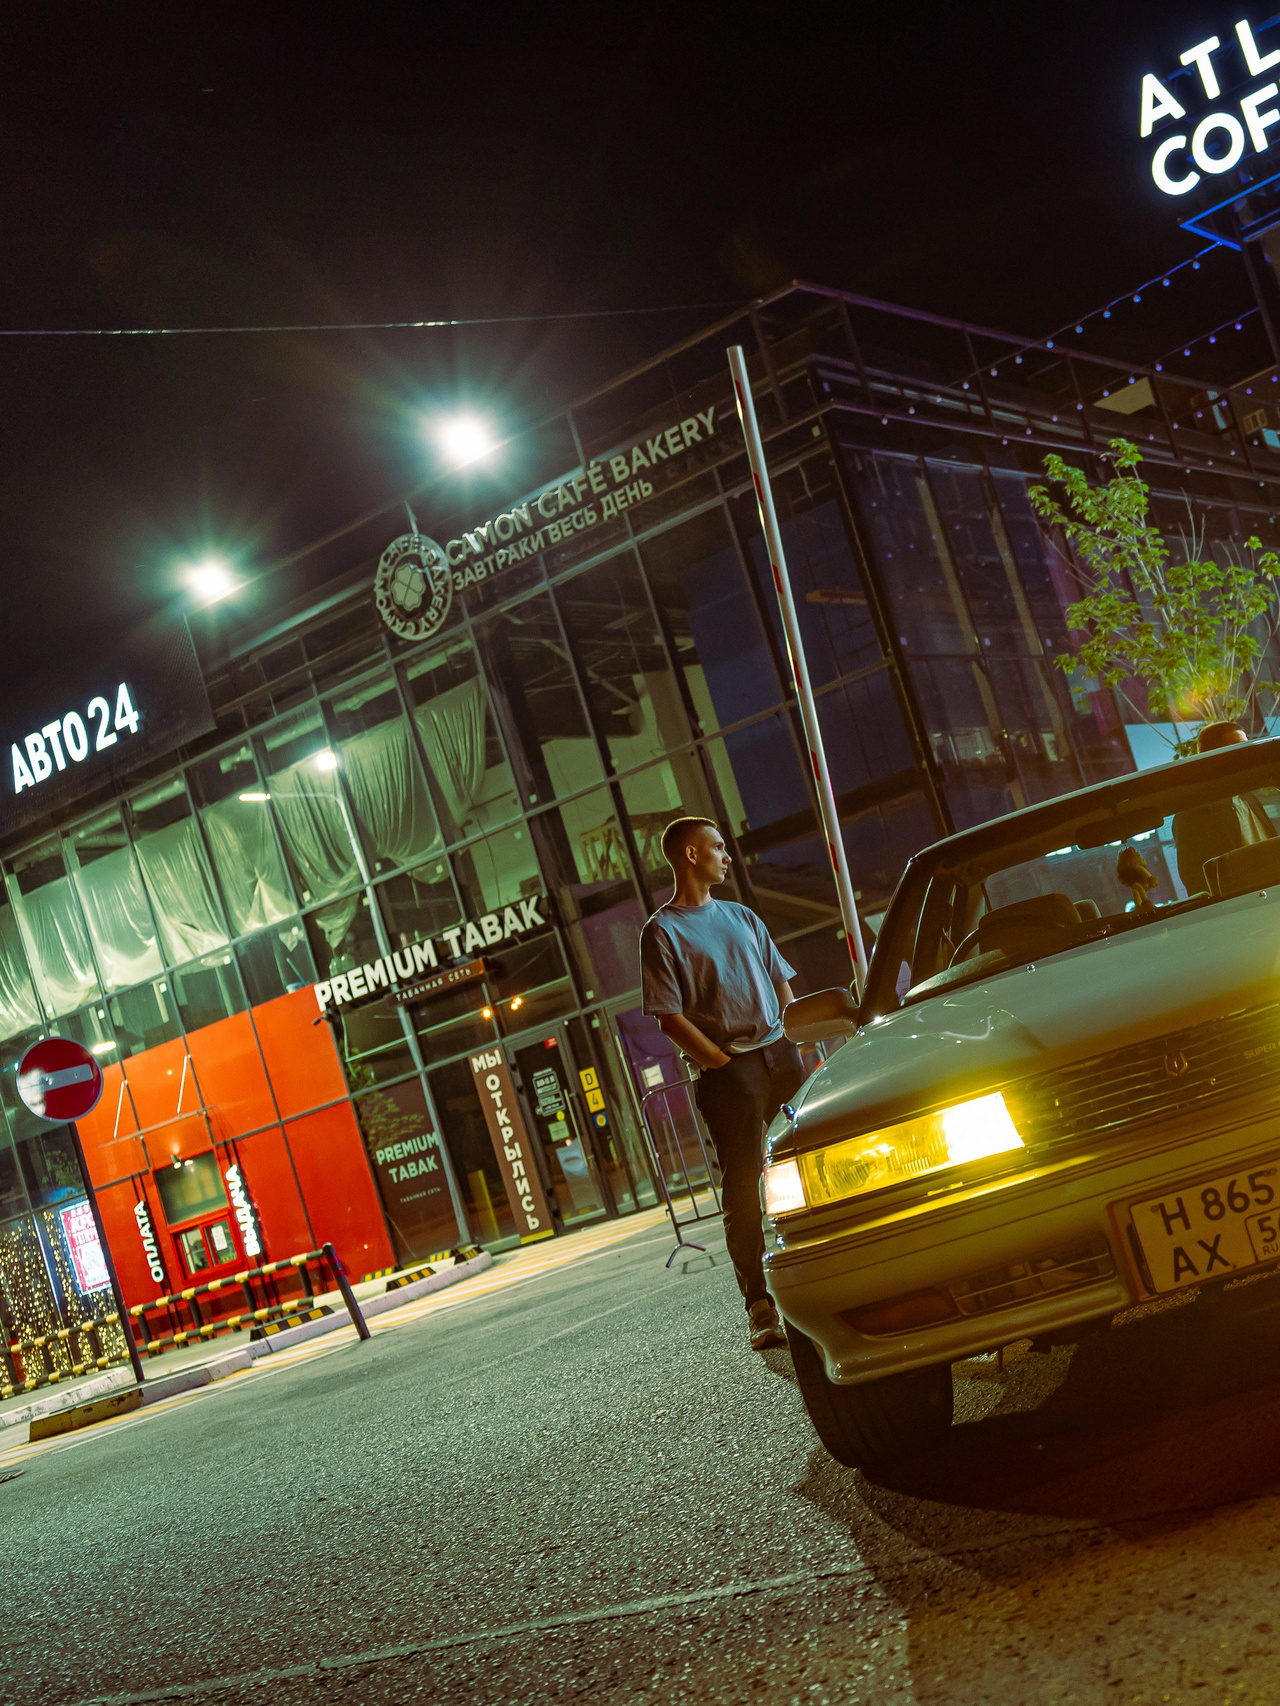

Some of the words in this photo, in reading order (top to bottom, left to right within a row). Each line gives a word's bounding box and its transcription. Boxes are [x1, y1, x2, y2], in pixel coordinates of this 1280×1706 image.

[445, 502, 534, 567] CAMON
[537, 461, 608, 519] CAFÉ
[609, 406, 716, 484] BAKERY
[454, 533, 545, 591] ЗАВТРАКИ
[550, 504, 598, 545] ВЕСЬ
[602, 478, 654, 521] ДЕНЬ
[11, 711, 88, 794] АВТО
[87, 682, 139, 752] 24
[313, 939, 438, 1012] PREMIUM
[443, 895, 546, 958] TABAK
[448, 967, 471, 984] СЕТЬ
[471, 1049, 502, 1073] МЫ
[1243, 1041, 1276, 1060] SUPER
[375, 1131, 440, 1166] PREMIUM
[388, 1155, 439, 1184] TABAK
[486, 1074, 540, 1231] ОТКРЫЛИСЬ
[225, 1164, 261, 1257] ВЫДАЧА
[1200, 1170, 1276, 1221] 865
[134, 1200, 164, 1283] ОПЛАТА
